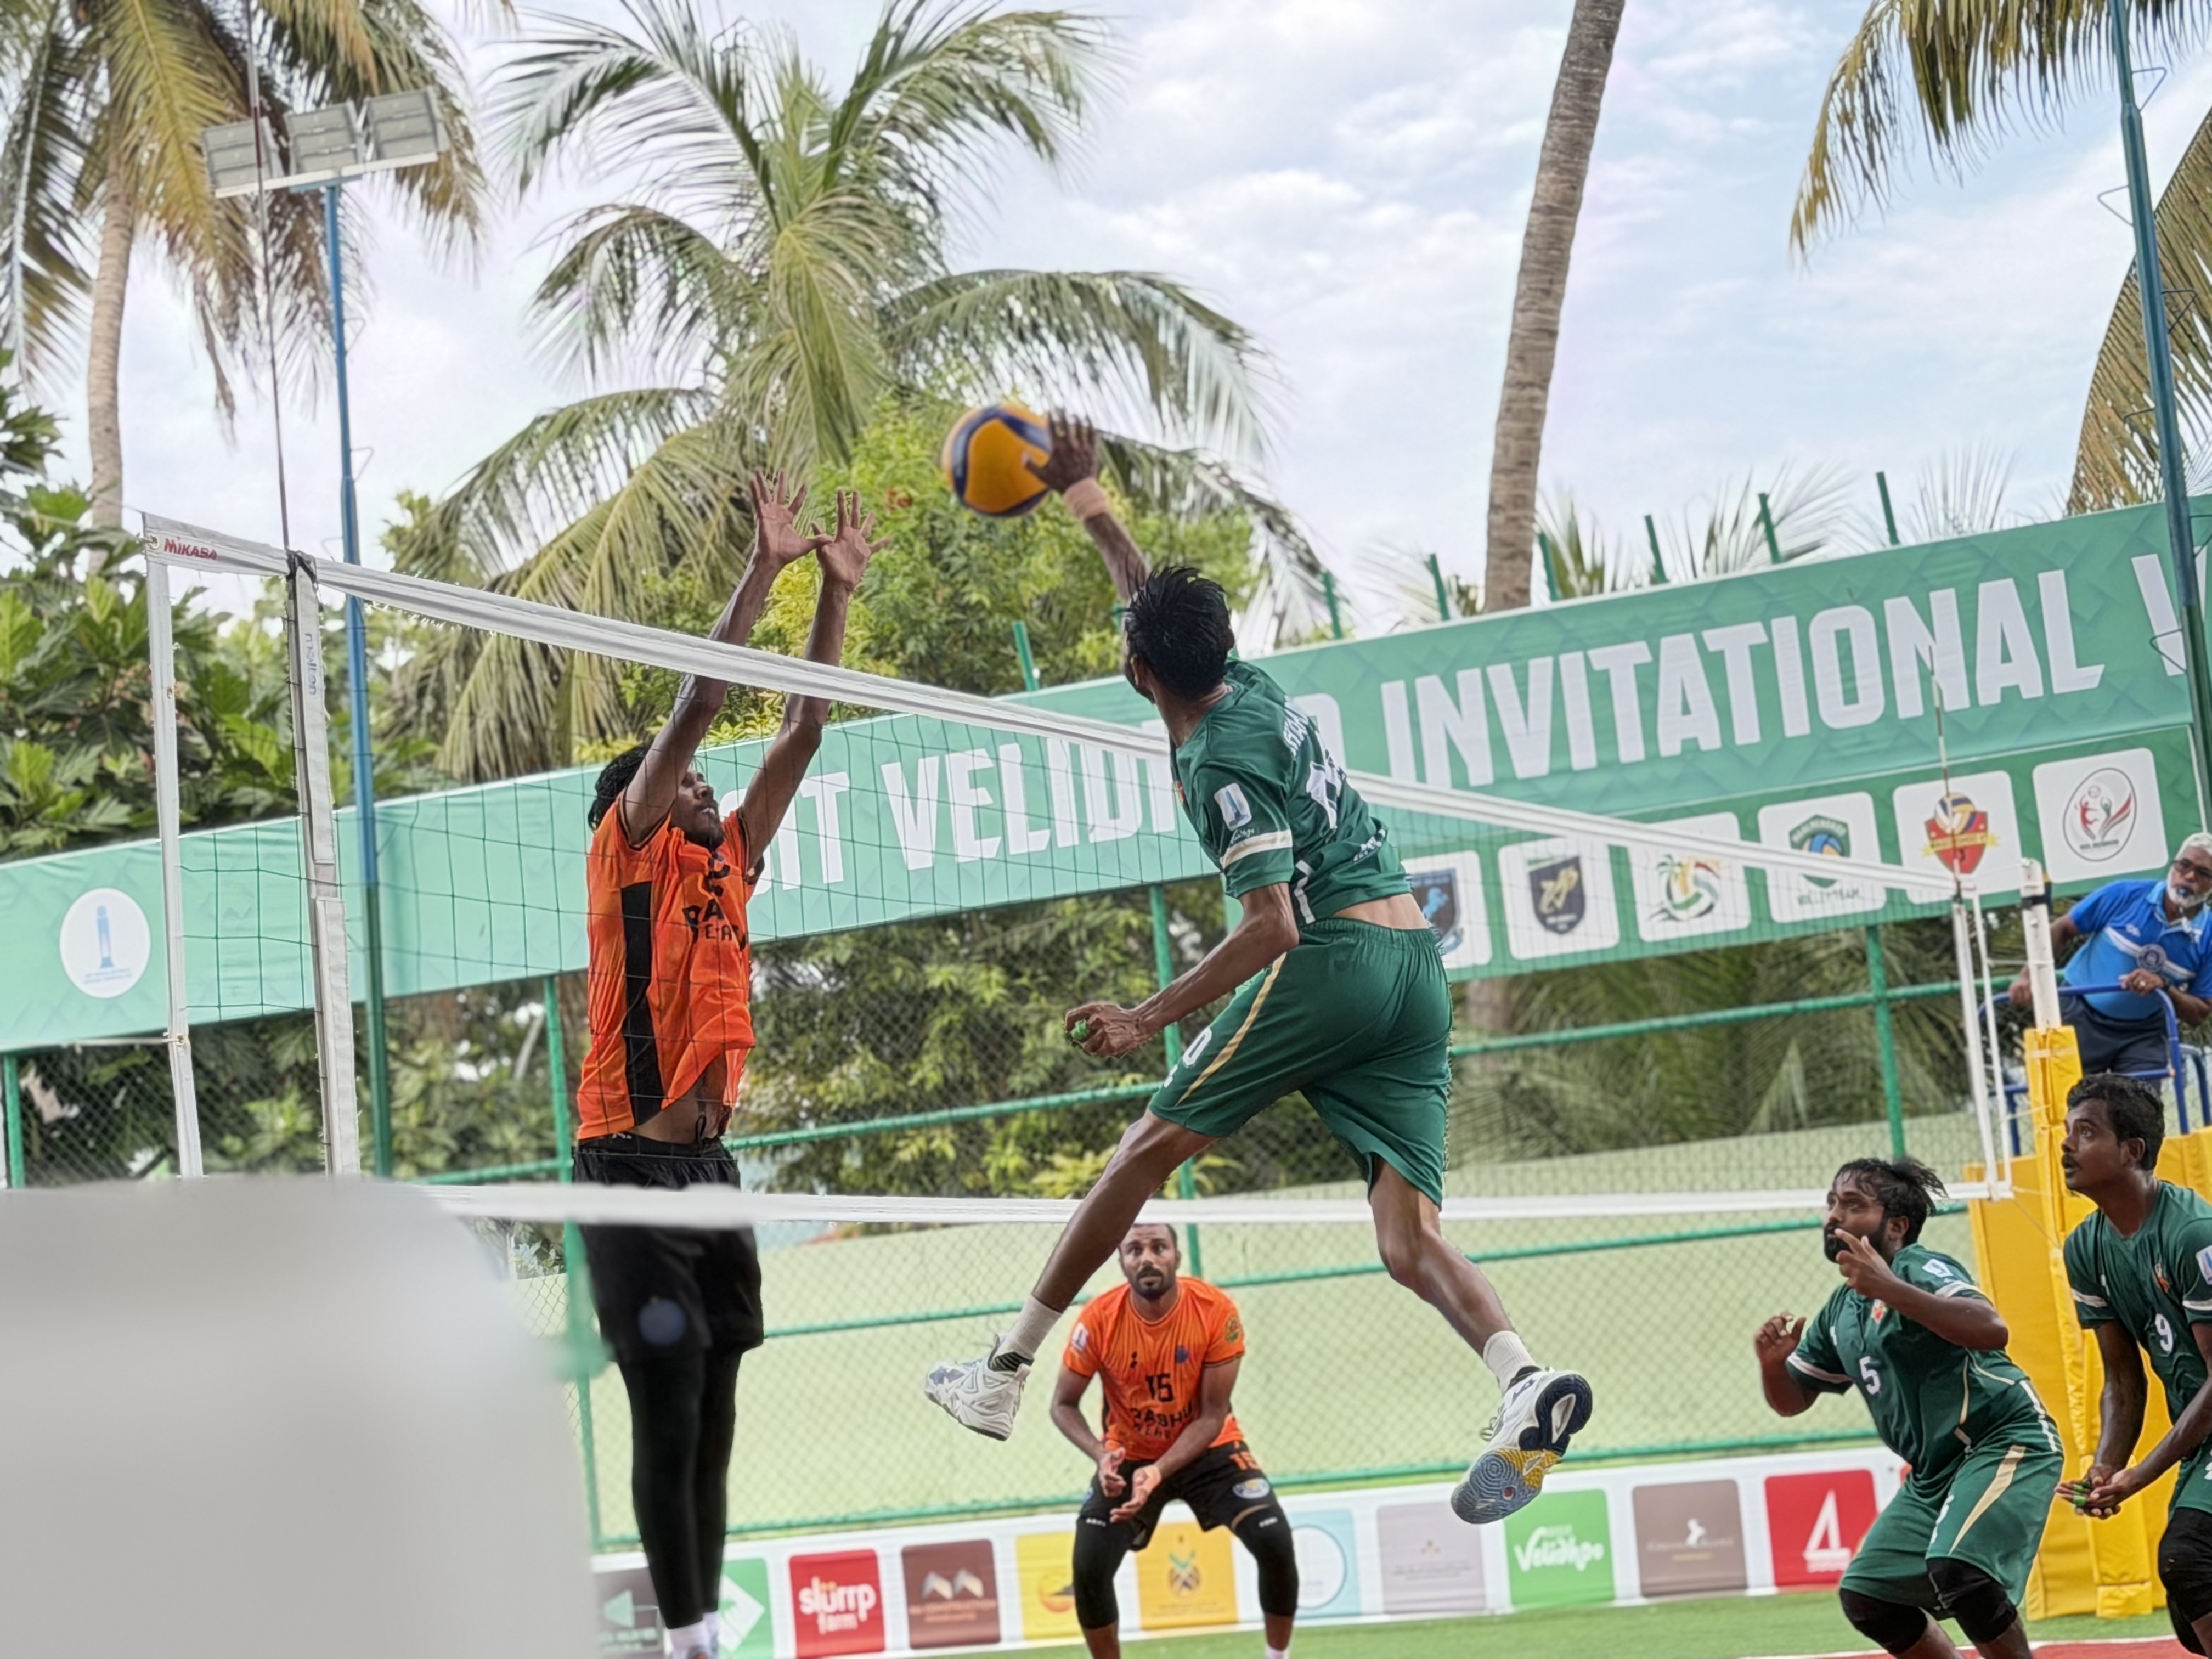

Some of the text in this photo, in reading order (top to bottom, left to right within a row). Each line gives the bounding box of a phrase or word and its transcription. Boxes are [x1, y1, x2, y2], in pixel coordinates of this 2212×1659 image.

[1381, 569, 2104, 791] INVITATIONAL
[2154, 1313, 2174, 1353] 9
[1145, 1373, 1175, 1402] 15
[1859, 1356, 1880, 1395] 5
